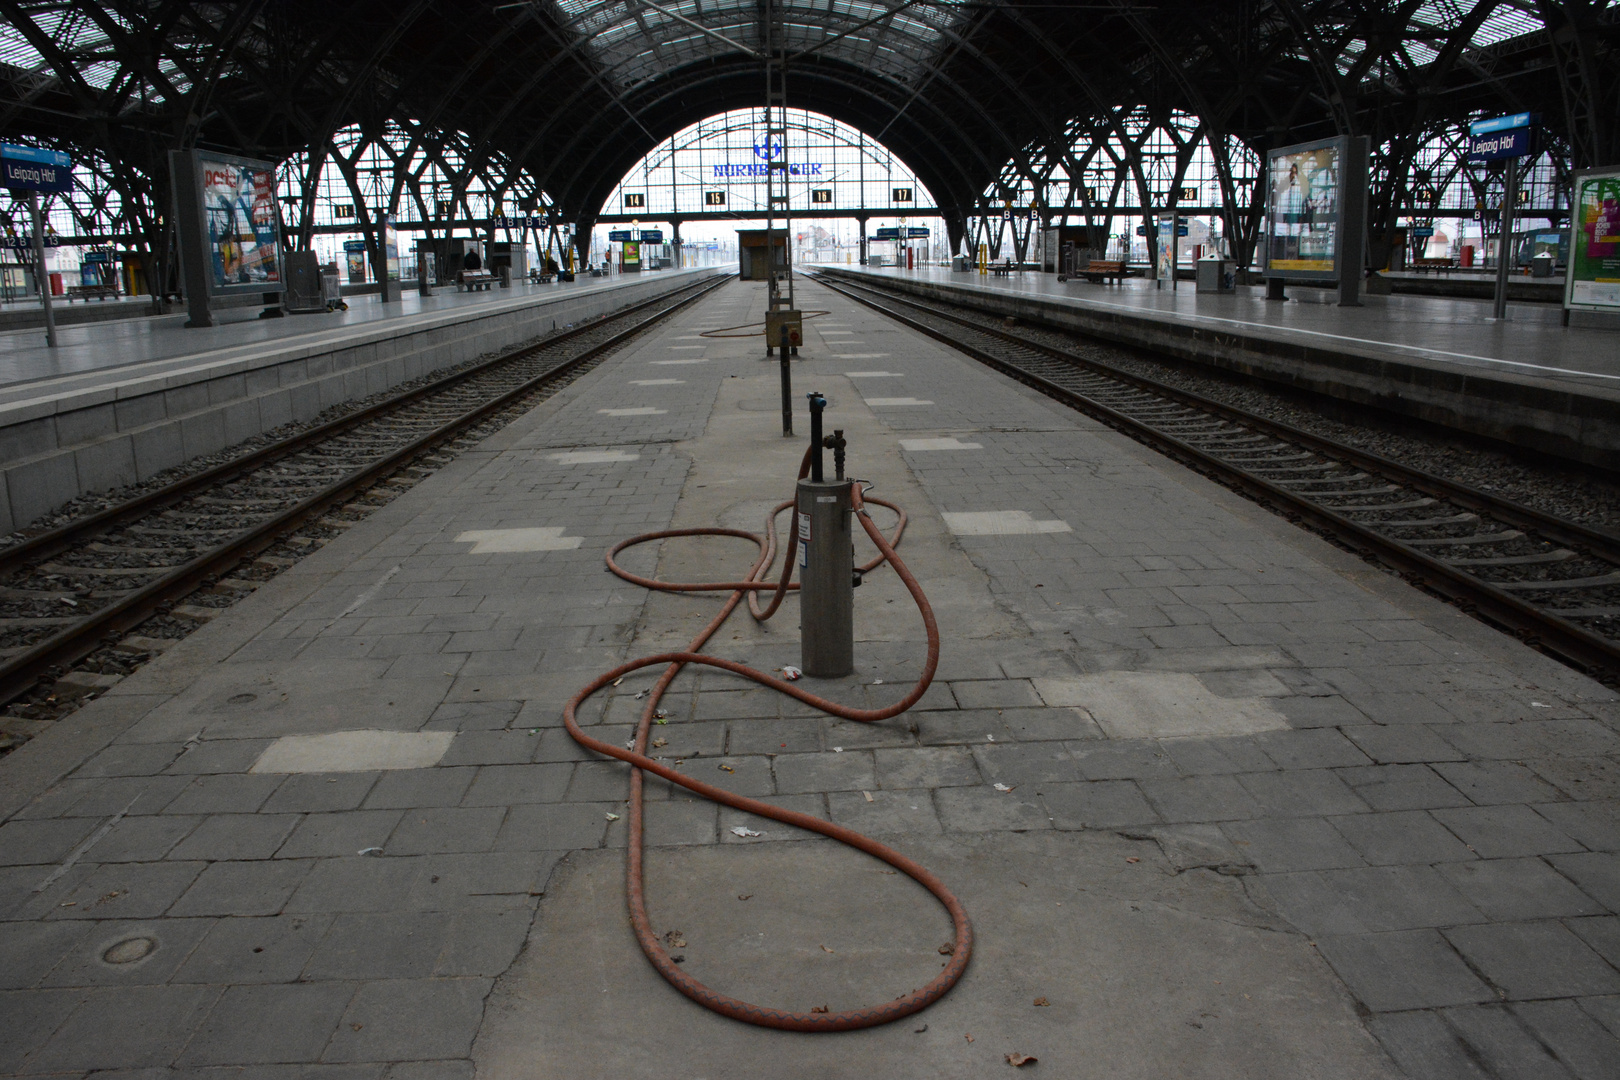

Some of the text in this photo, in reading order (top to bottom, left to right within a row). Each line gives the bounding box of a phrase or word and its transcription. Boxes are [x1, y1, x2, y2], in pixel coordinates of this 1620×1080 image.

[1471, 135, 1515, 155] Leipzig Hbf
[7, 164, 56, 184] Leipzig Hbf
[630, 195, 639, 206] 14
[711, 193, 720, 204] 15
[818, 191, 827, 202] 16
[898, 189, 907, 201] 17
[339, 205, 348, 217] 11
[1003, 210, 1011, 220] B
[1031, 209, 1038, 219] B
[1474, 210, 1481, 220] B
[493, 217, 514, 228] 14 B
[526, 216, 548, 227] B 15
[5, 237, 27, 247] 12 B
[48, 236, 59, 246] 13
